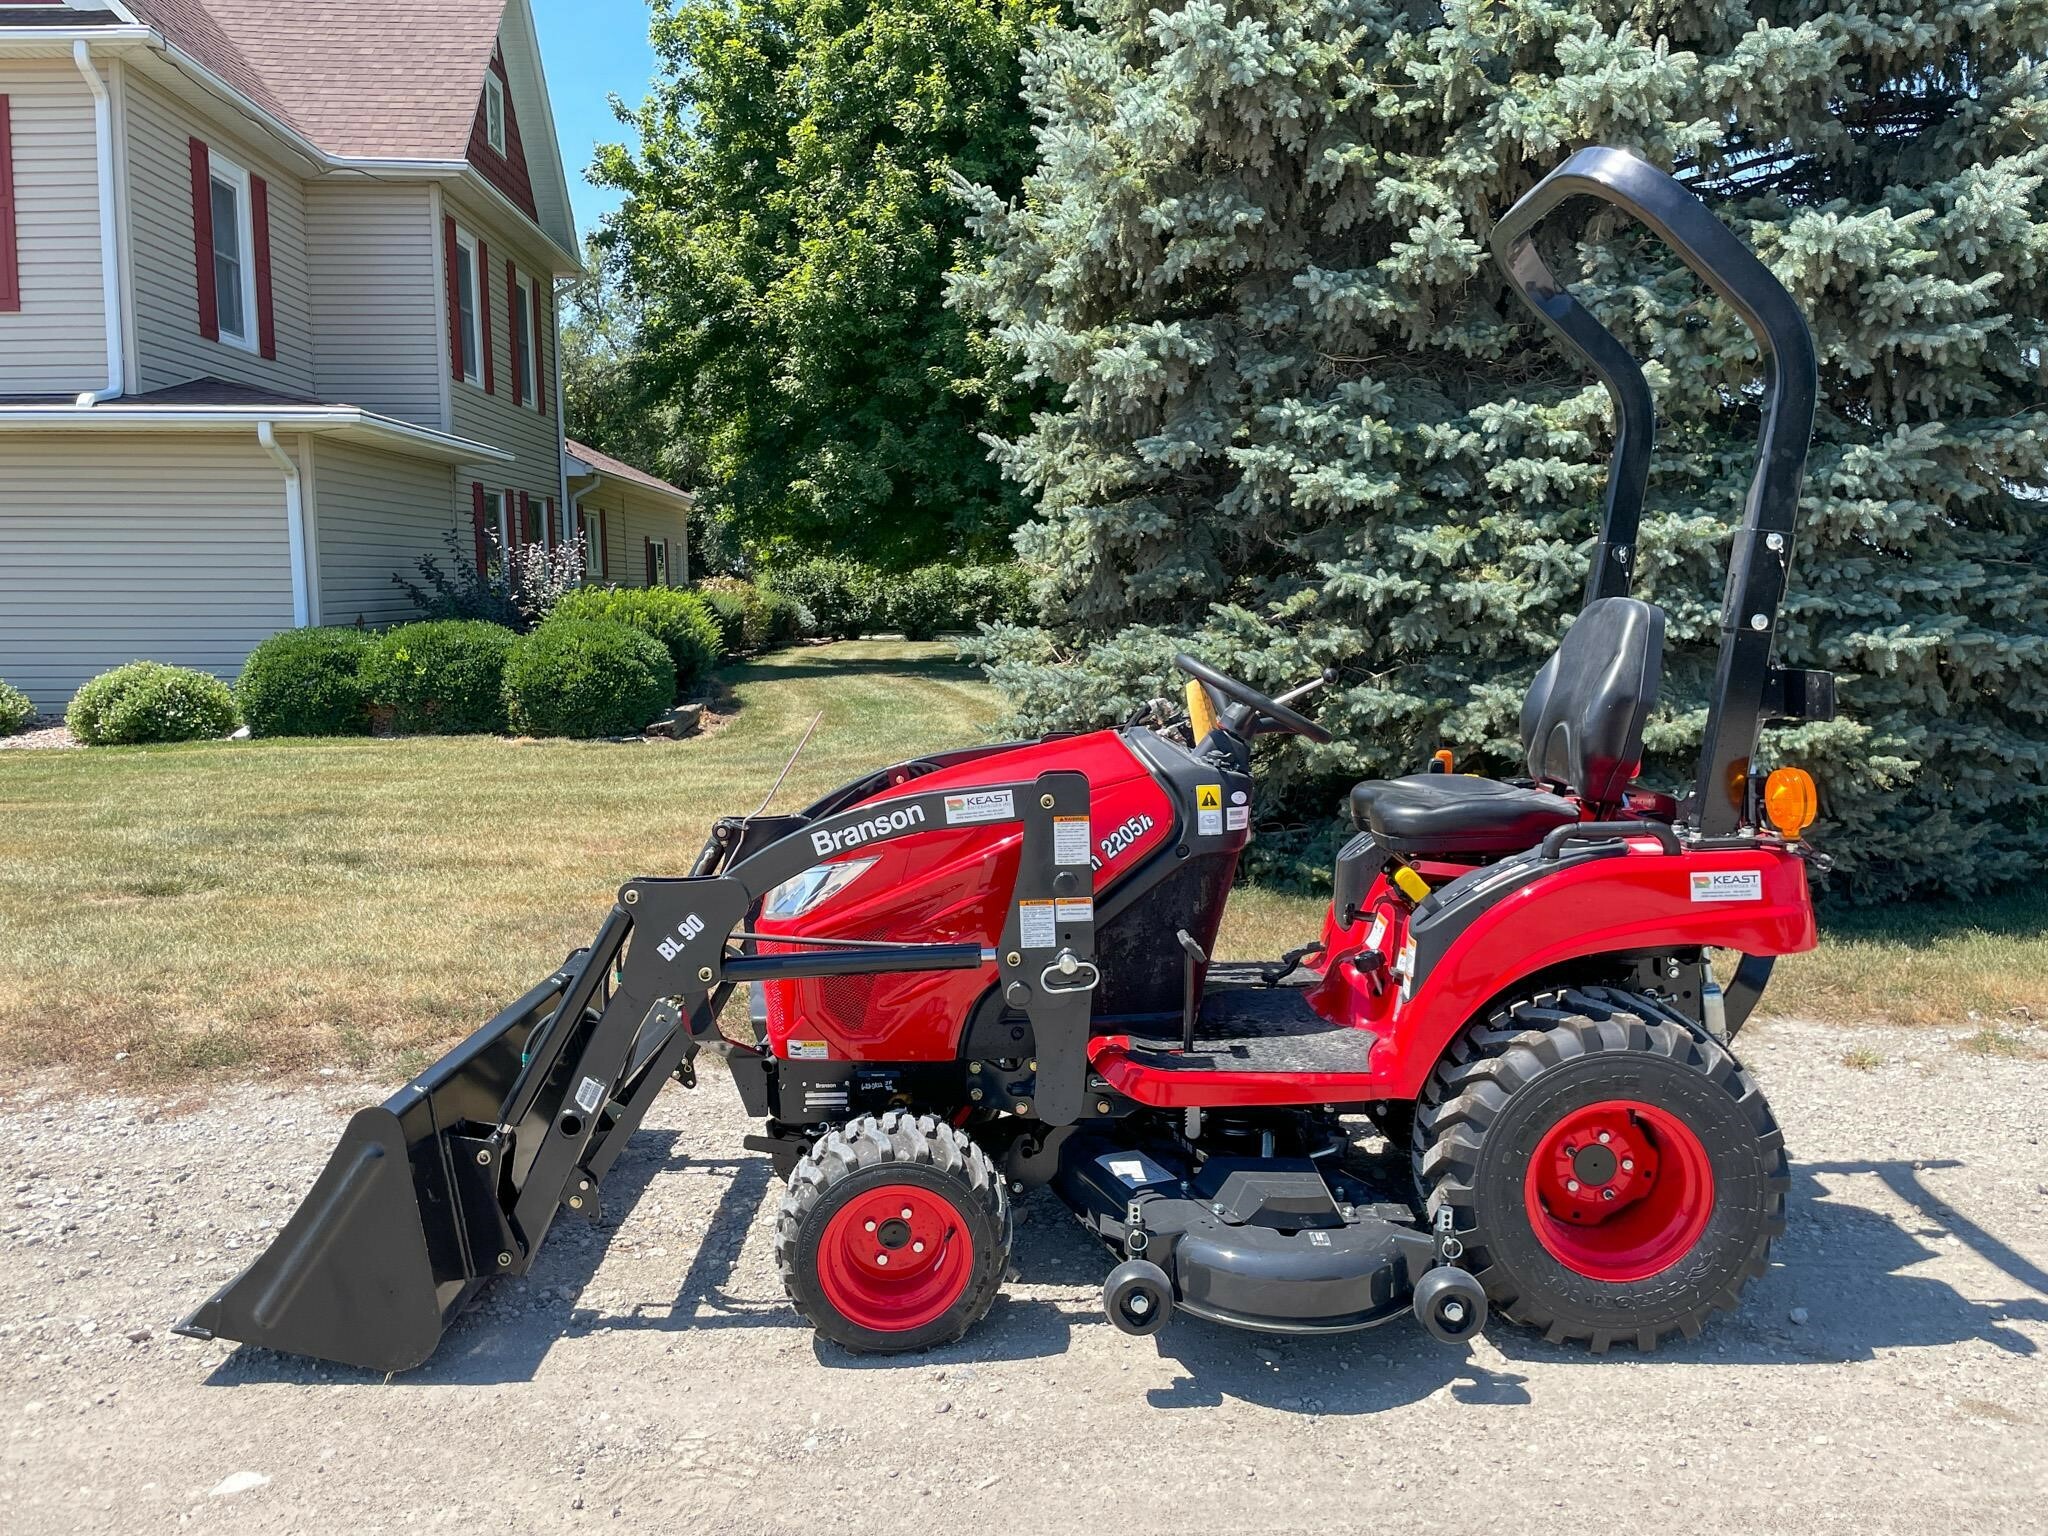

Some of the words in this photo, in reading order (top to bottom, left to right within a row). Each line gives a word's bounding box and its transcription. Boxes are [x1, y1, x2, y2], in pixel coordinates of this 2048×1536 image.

[966, 793, 1011, 806] KEAST
[811, 804, 926, 857] Branson
[1100, 814, 1154, 859] 2205h
[1713, 874, 1759, 884] KEAST
[656, 936, 685, 962] BL
[677, 914, 705, 941] 90
